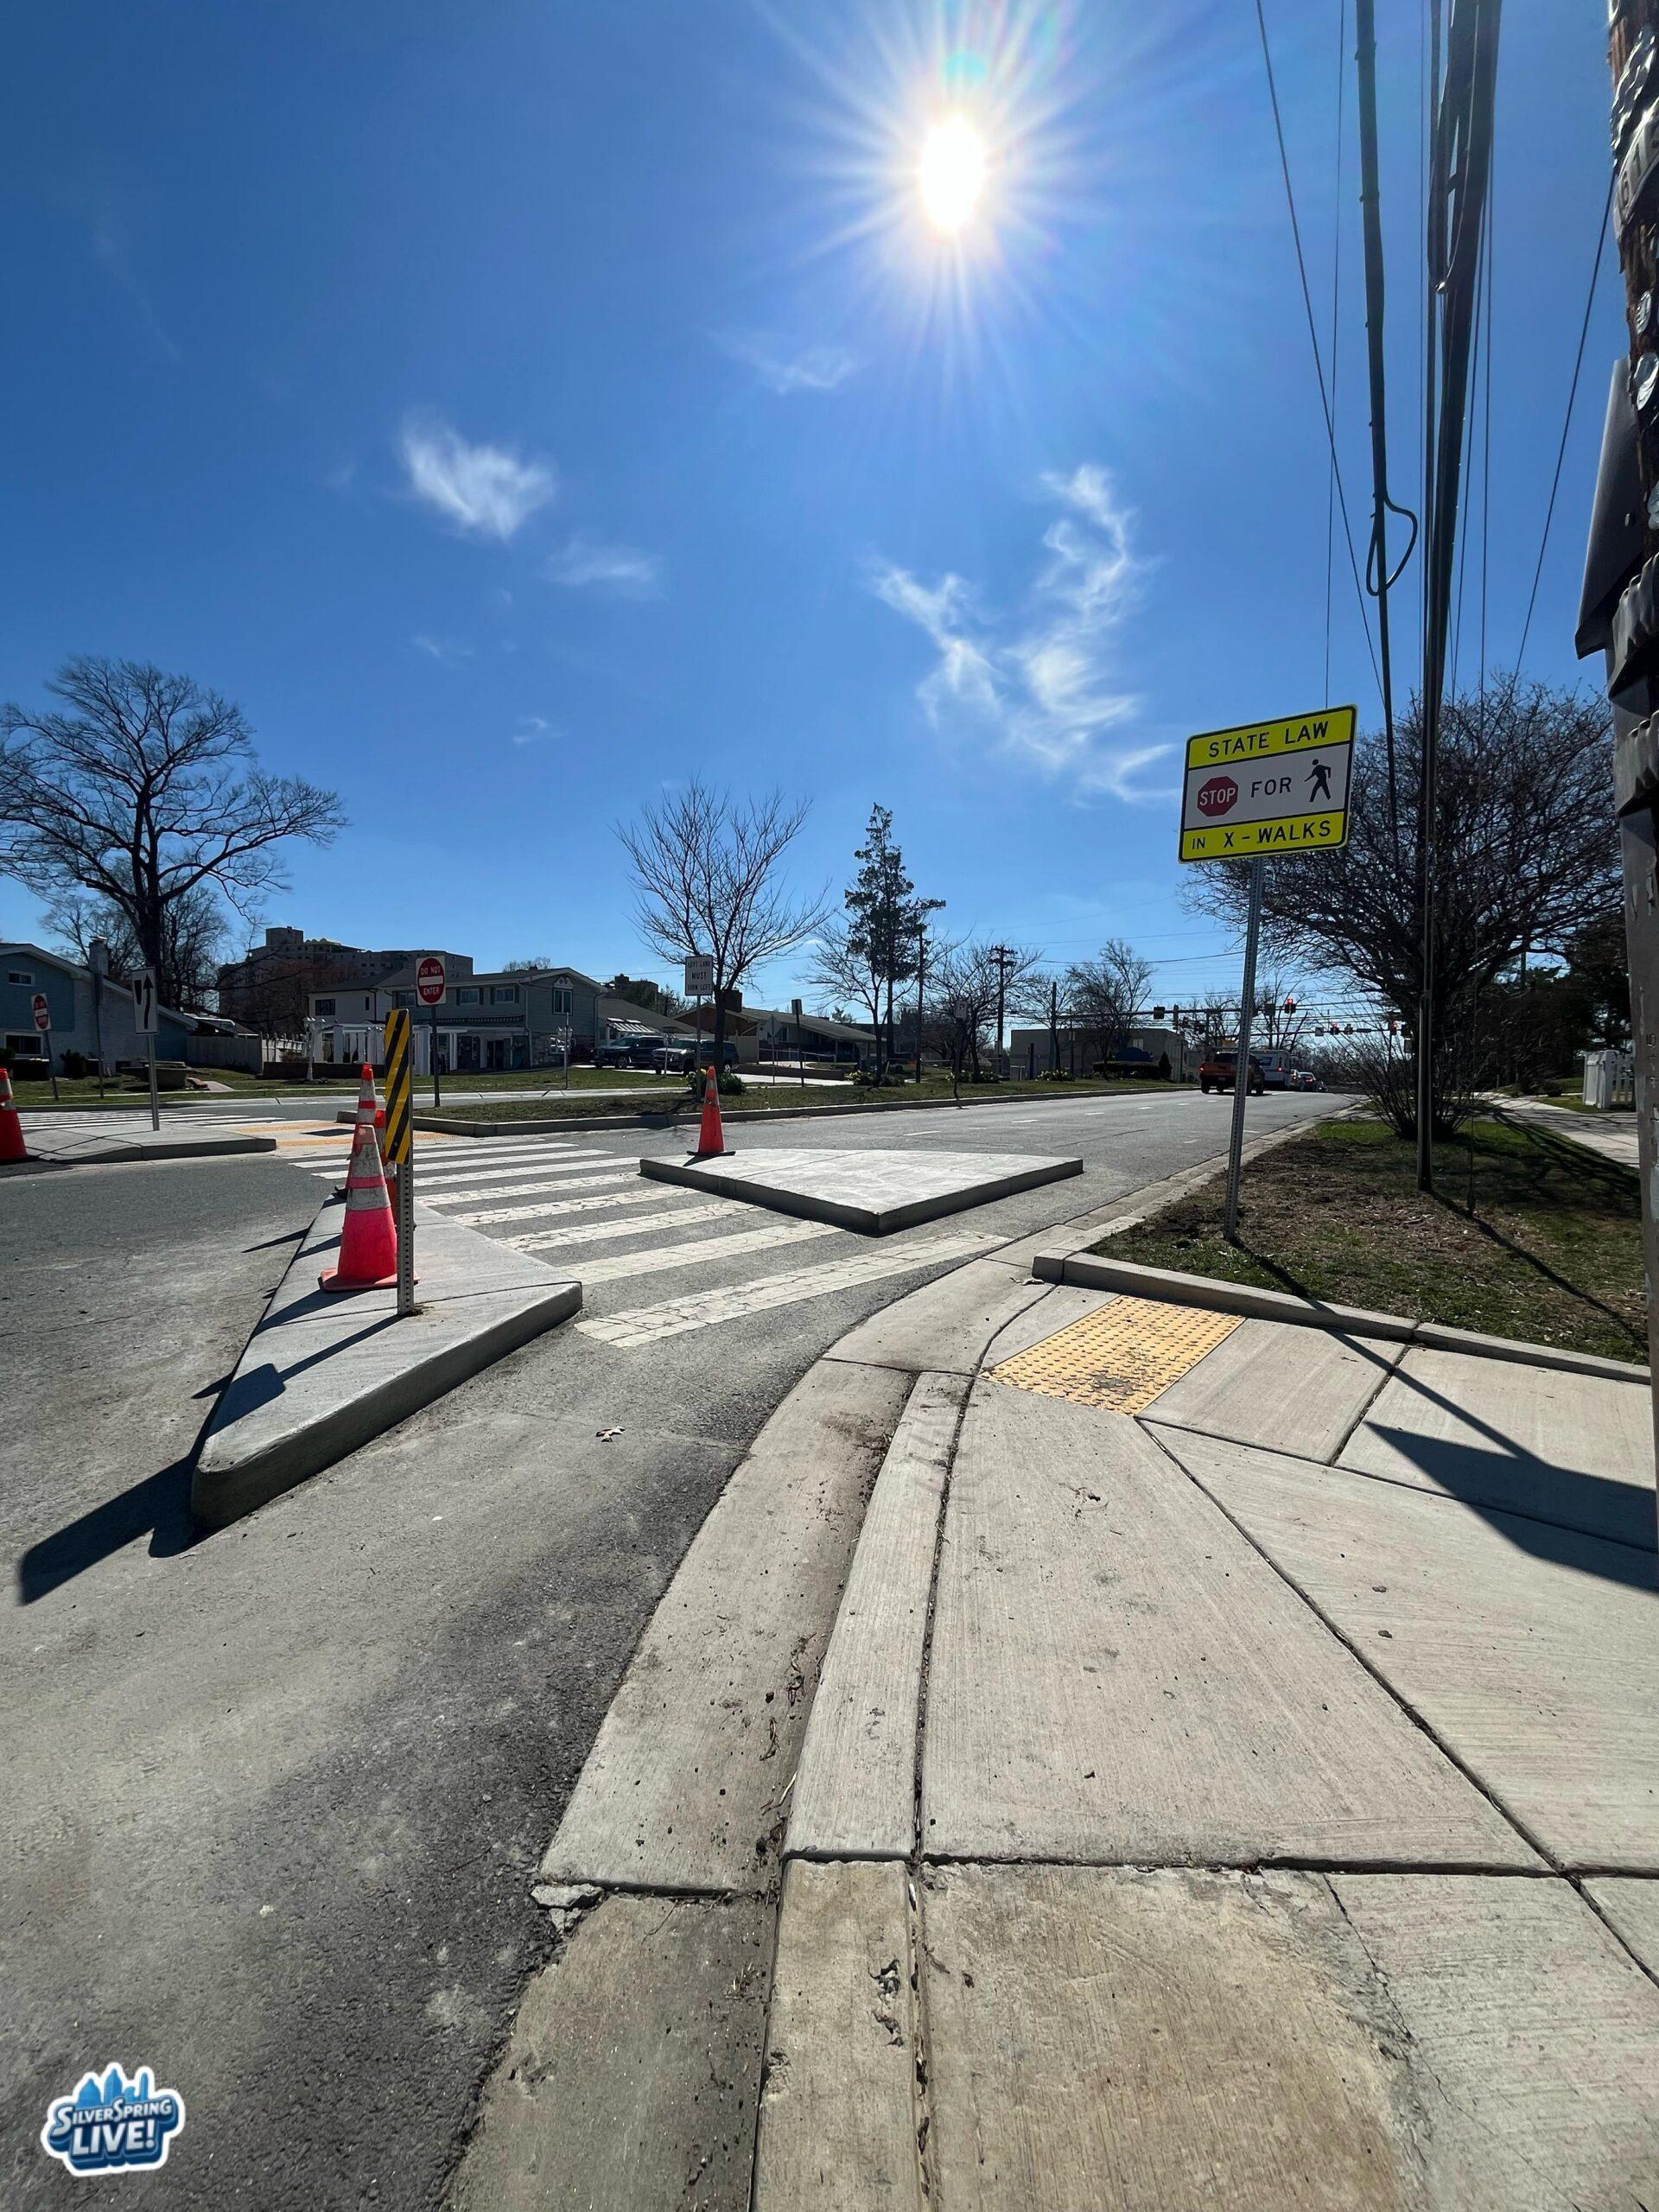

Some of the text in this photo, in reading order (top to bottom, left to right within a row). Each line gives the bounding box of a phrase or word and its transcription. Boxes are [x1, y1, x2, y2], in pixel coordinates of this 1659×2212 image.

[1208, 721, 1329, 758] STATE LAW
[1199, 777, 1292, 806] STOP FOR
[1192, 836, 1206, 850] IN
[430, 966, 441, 975] NOT
[691, 971, 707, 980] MUST
[423, 987, 440, 995] ENTER
